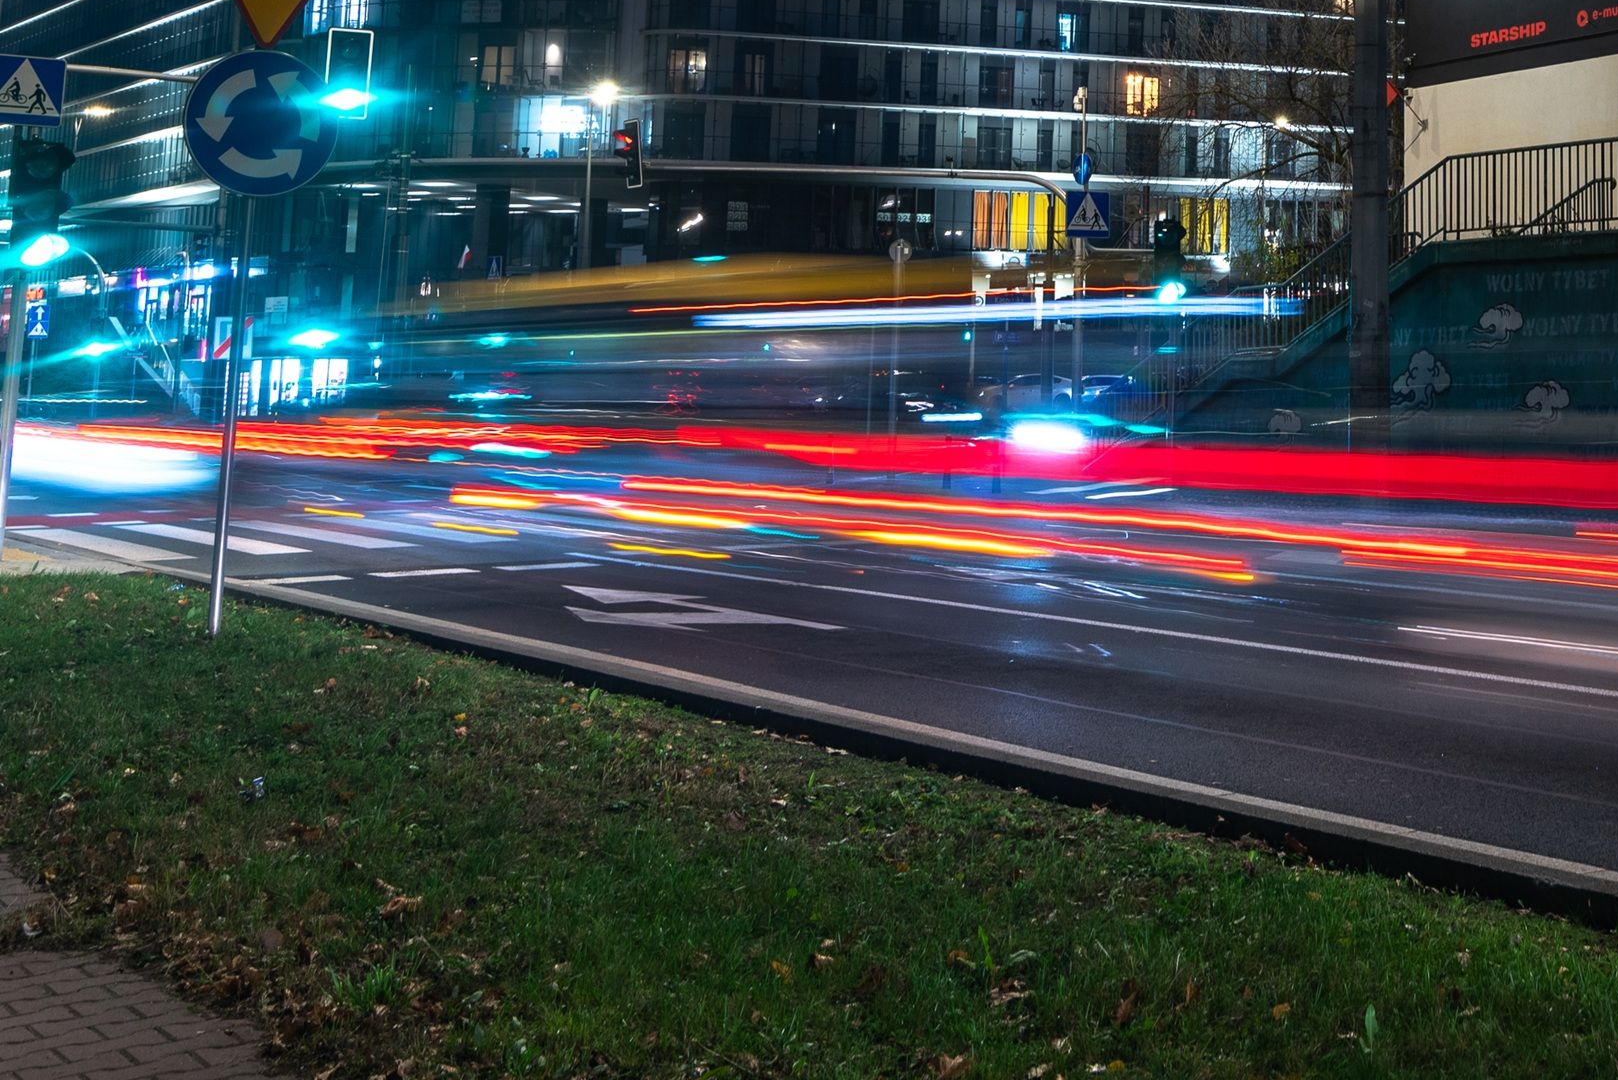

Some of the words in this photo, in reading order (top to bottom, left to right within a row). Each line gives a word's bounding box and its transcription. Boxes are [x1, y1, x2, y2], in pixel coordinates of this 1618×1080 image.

[1470, 20, 1547, 48] STARSHIP
[1486, 271, 1545, 293] WOLNY
[1552, 268, 1610, 291] TYBET
[1418, 325, 1469, 346] TYBET
[1522, 313, 1584, 337] WOLNY
